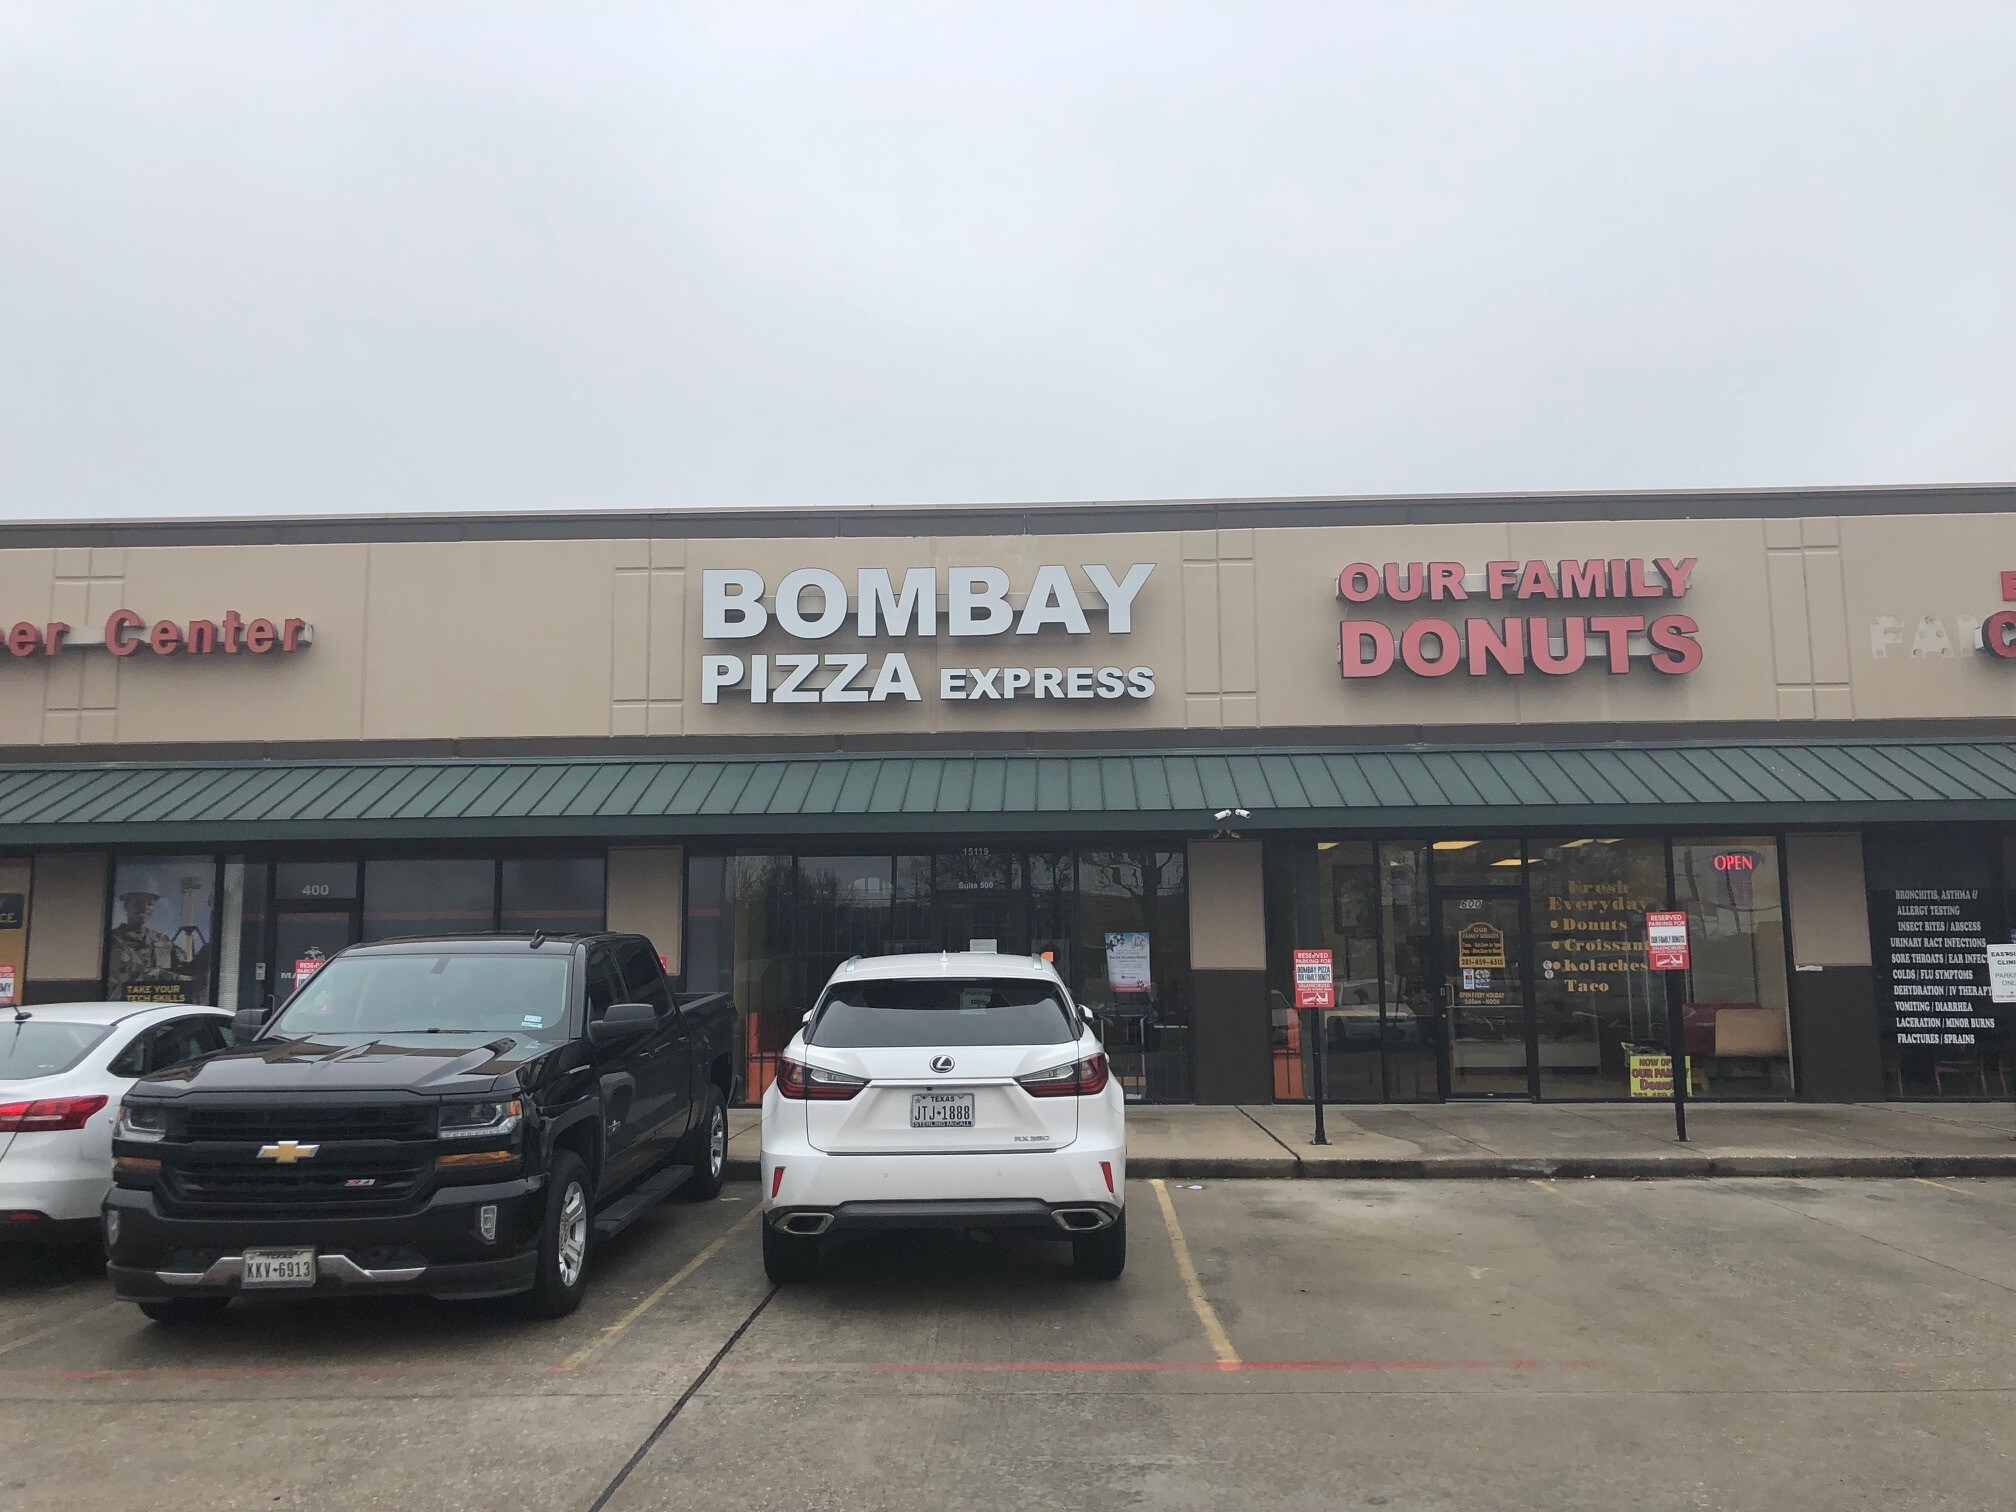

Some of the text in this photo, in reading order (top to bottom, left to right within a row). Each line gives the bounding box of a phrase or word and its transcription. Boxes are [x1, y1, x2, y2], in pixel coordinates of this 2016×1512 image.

[1338, 557, 1698, 602] OUR FAMILY
[701, 563, 1157, 639] BOMBAY
[0, 608, 306, 657] er Center
[1340, 614, 1702, 679] DONUTS
[701, 652, 1156, 704] PIZZA EXPRESS
[1714, 855, 1753, 870] OPEN
[302, 884, 330, 895] 400
[958, 881, 994, 889] Suite 500
[1568, 880, 1629, 894] Fresh
[1895, 889, 1941, 901] BRONCHITIS,
[1941, 889, 1971, 900] ASTHMA
[1461, 900, 1482, 909] 600
[1548, 896, 1649, 913] Everyday
[1897, 905, 1960, 916] ALLERGY TESTING
[1562, 917, 1628, 931] Donuts
[1898, 921, 1923, 931] INSECT
[1924, 921, 1945, 931] BITES
[1950, 921, 1981, 931] ABSCESS
[1658, 935, 1671, 943] FAMILY
[1671, 935, 1685, 943] DONUTS
[1890, 937, 1922, 948] URINARY
[1944, 937, 1986, 948] INFECTIONS
[1891, 954, 1911, 964] SORE
[1911, 954, 1944, 964] THROATS
[1948, 954, 1964, 964] EAR
[1563, 958, 1649, 973] Kolaches
[1892, 970, 1916, 980] COLDS
[1920, 970, 1934, 980] FLU
[1935, 970, 1973, 980] SYMPTOMS
[127, 985, 181, 993] TAKE YOUR
[1564, 978, 1610, 992] Taco
[1894, 986, 1945, 996] DEHYDRATION
[1949, 986, 1957, 996] IV
[126, 994, 185, 1002] TECH SKILLS
[1895, 1002, 1931, 1012] VOMITING
[1935, 1002, 1973, 1012] DIARRHEA
[1896, 1018, 1941, 1028] LACERATION
[1946, 1018, 1970, 1028] MINOR
[1971, 1018, 1995, 1028] BURNS
[1897, 1034, 1939, 1044] FRACTURES
[1944, 1034, 1975, 1044] SPRAINS
[1631, 1068, 1653, 1078] OUR
